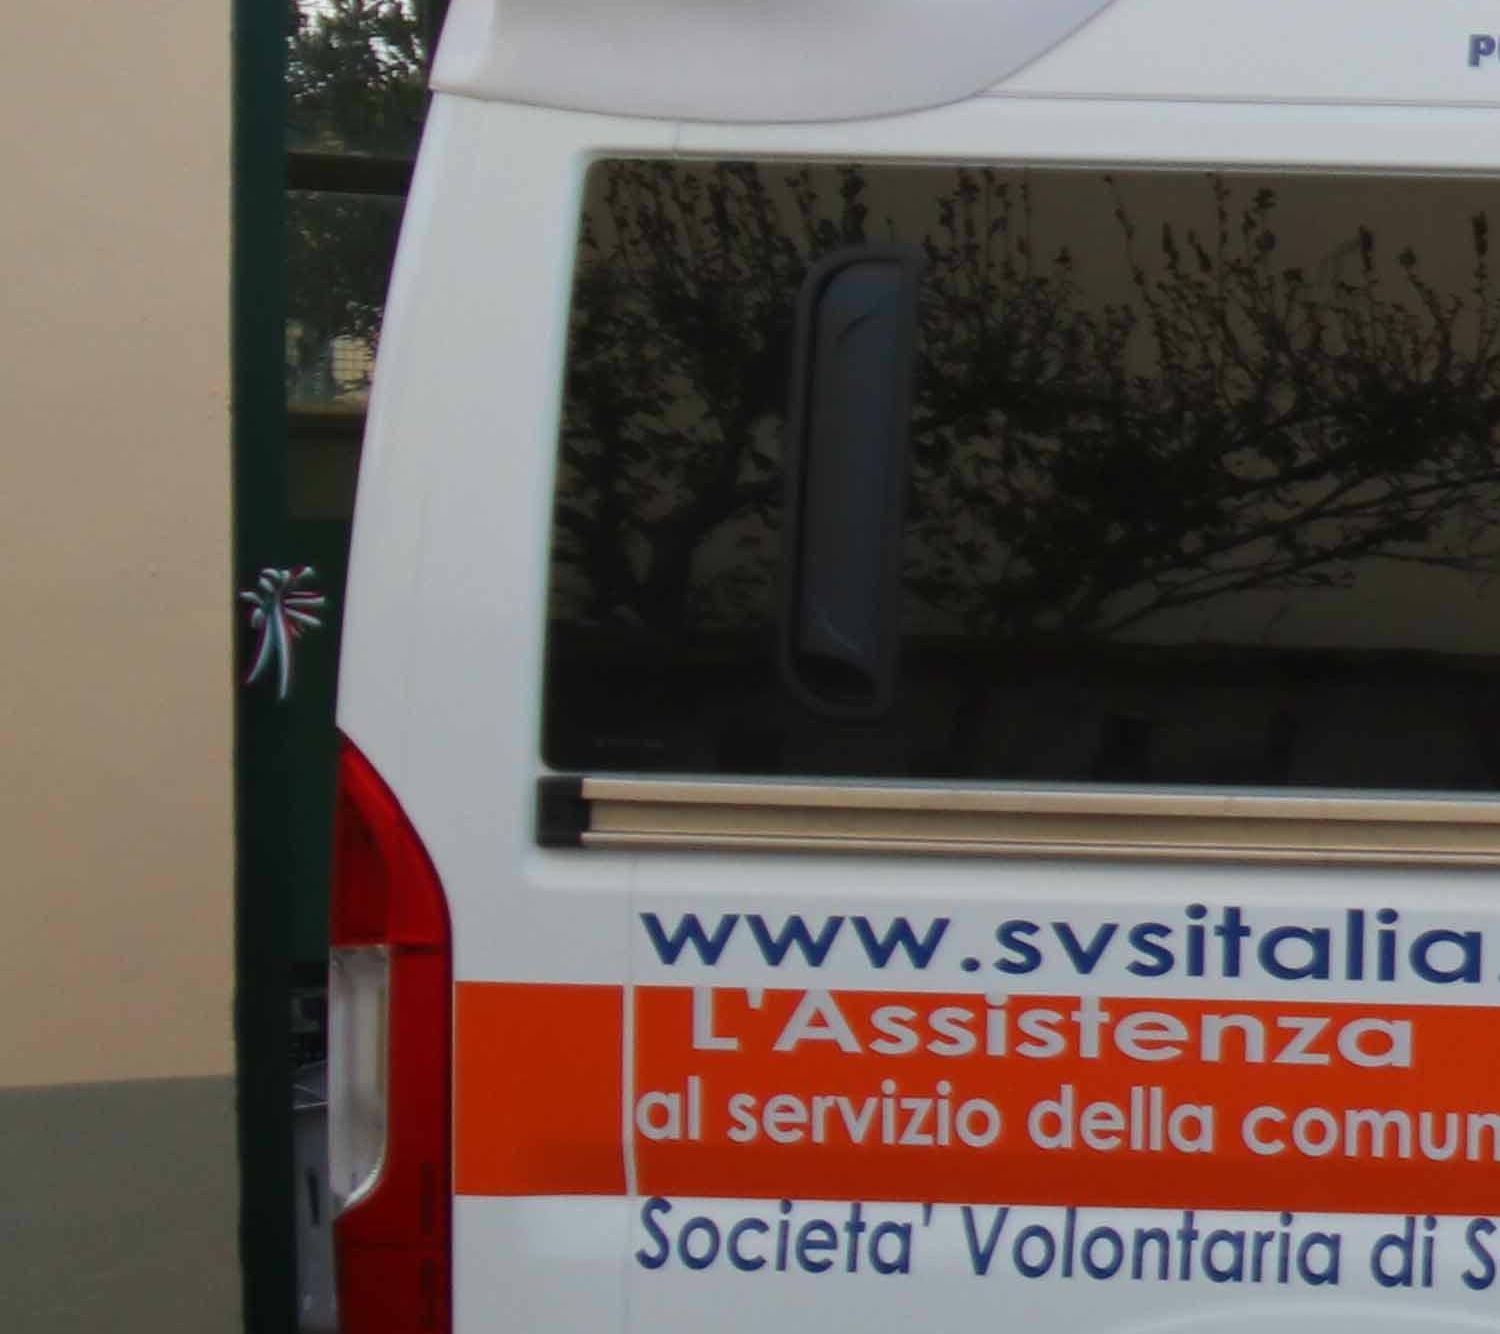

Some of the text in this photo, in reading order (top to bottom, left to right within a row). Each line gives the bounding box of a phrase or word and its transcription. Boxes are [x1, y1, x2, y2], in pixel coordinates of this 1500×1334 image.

[692, 986, 1413, 1068] L'Assistenza
[635, 1076, 700, 1142] al
[727, 1079, 1001, 1148] servizio
[1027, 1084, 1213, 1154] della
[635, 1196, 934, 1278] Societa'
[961, 1203, 1341, 1287] Volontaria
[1369, 1213, 1437, 1291] di
